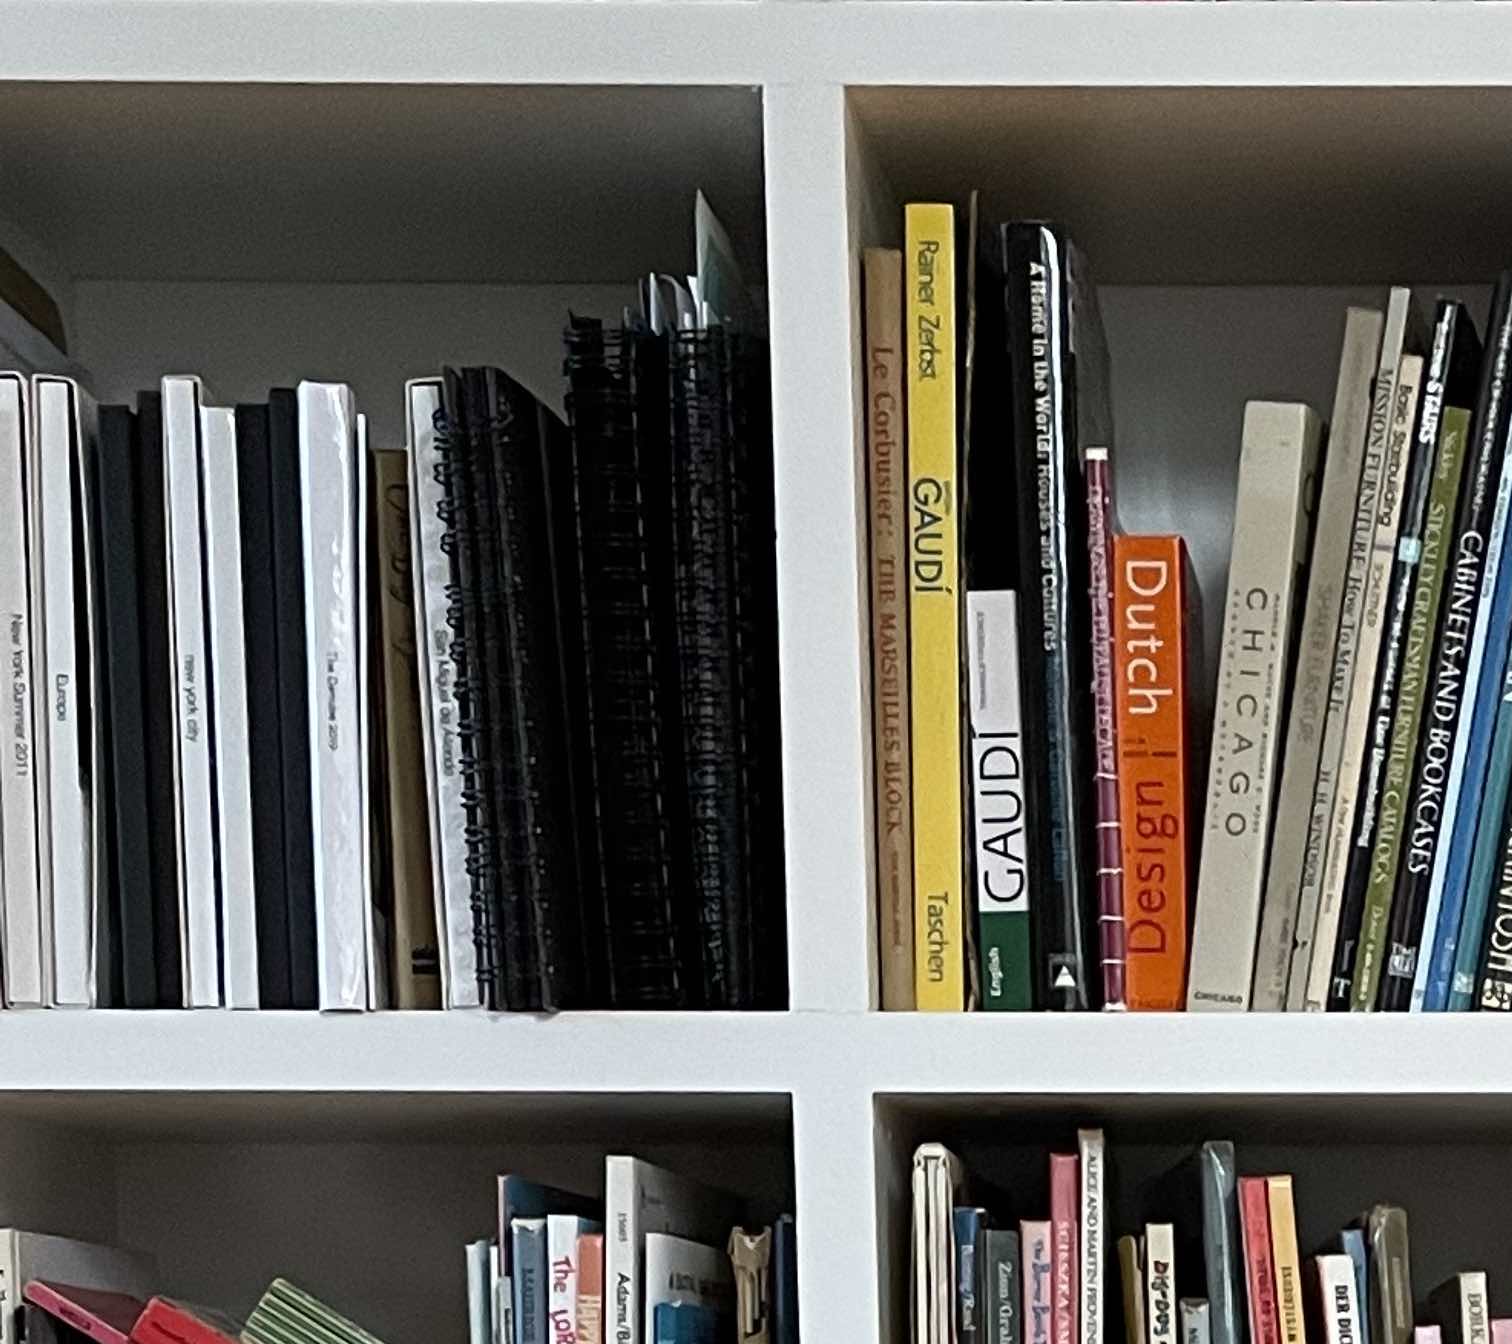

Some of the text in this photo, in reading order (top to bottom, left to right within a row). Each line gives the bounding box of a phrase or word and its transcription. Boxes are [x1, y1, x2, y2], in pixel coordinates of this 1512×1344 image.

[918, 240, 940, 380] Rainer Zerbst
[1369, 369, 1394, 448] MISSION
[1419, 381, 1444, 443] STAIRS
[1378, 385, 1413, 527] Basic Stairbuilding
[913, 478, 951, 593] GAUDÍ
[1352, 454, 1383, 563] FURNITURE
[1126, 561, 1174, 715] Dutch
[1225, 588, 1268, 836] CHICAGO
[1408, 532, 1484, 875] CABINETS AND BOOKCASES
[884, 761, 905, 835] BLOCK
[1373, 697, 1419, 883] FURNITURE CATALOGS
[1126, 781, 1178, 955] Design
[1303, 814, 1326, 887] WINDSOR
[927, 892, 950, 982] Taschen
[1087, 1156, 1099, 1191] ALICE
[1087, 1195, 1099, 1227] AND
[554, 1257, 575, 1292] The
[1087, 1230, 1100, 1284] MARTIN
[1334, 1285, 1350, 1313] DER
